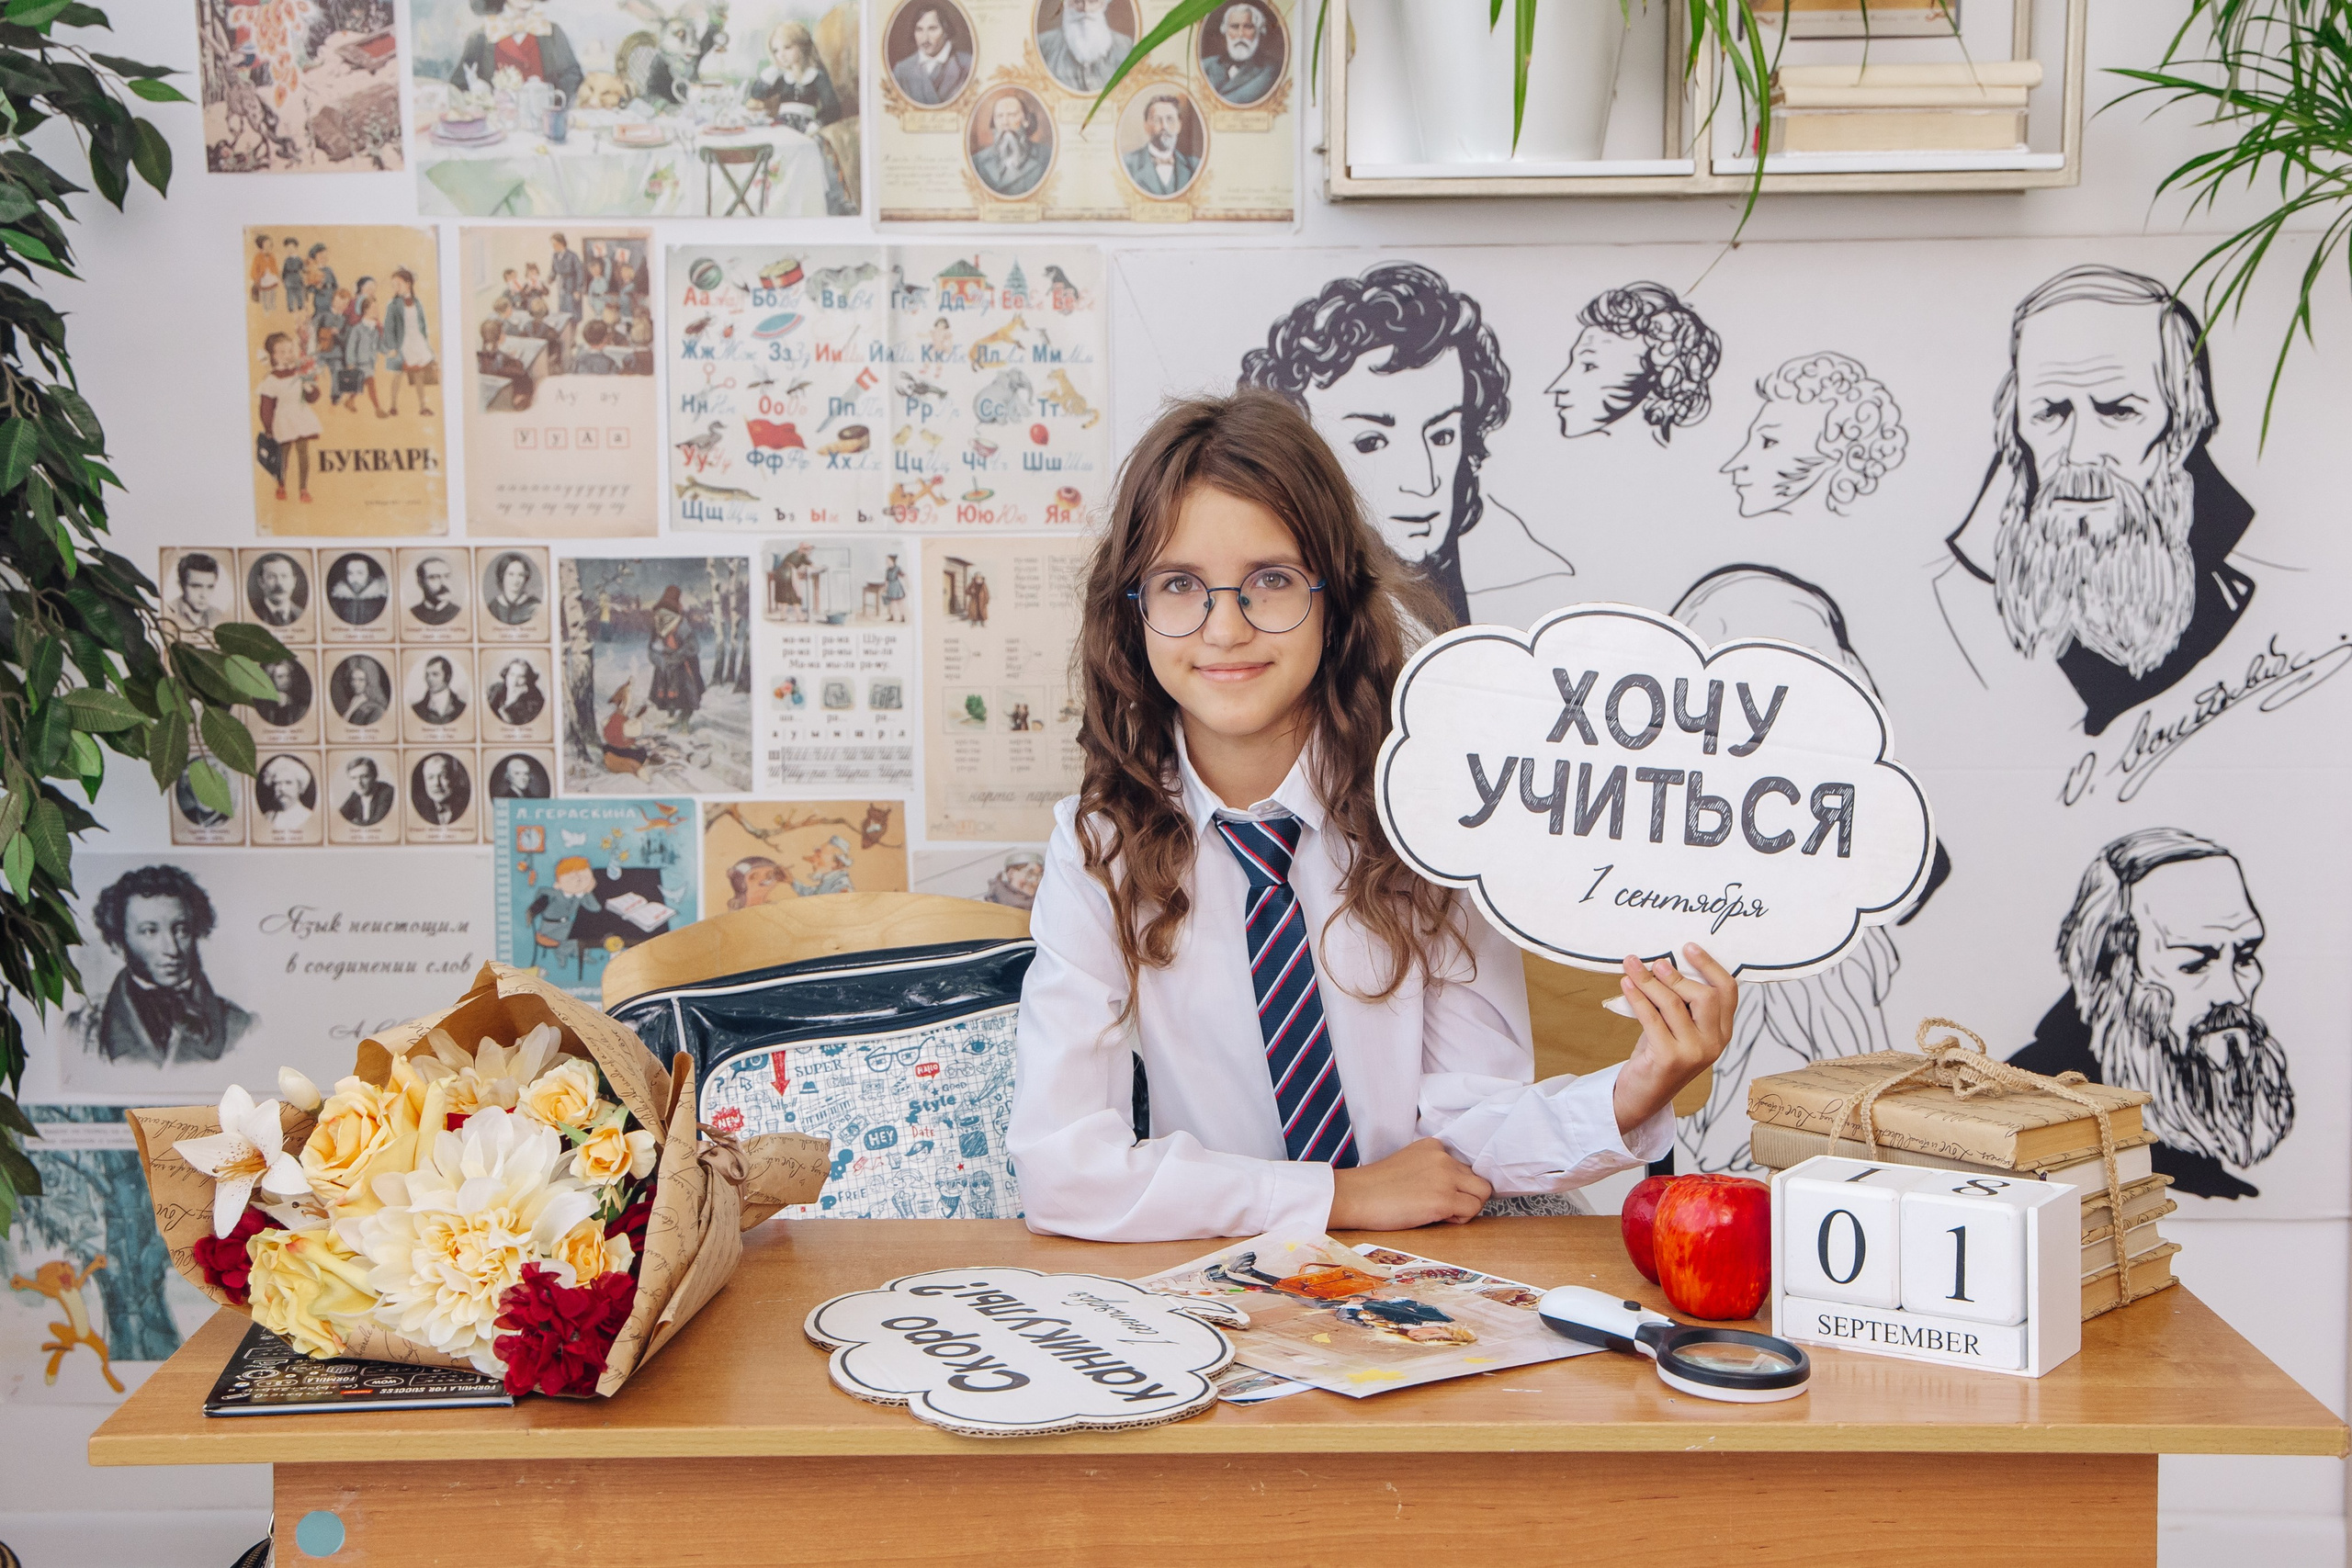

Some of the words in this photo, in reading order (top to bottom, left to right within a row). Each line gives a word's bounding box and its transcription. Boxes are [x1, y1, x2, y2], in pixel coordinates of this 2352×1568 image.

[683, 286, 710, 307] Аа
[752, 288, 777, 307] Бб
[821, 289, 848, 309] Вв
[939, 290, 965, 311] Дд
[682, 340, 715, 360] Жж
[769, 342, 792, 361] Зз
[816, 343, 842, 363] Ии
[922, 344, 944, 363] Кк
[1033, 344, 1062, 363] Мм
[682, 395, 707, 412] Нн
[759, 396, 785, 414] Оо
[829, 397, 855, 416] Пп
[906, 398, 933, 423] Рр
[979, 399, 1004, 415] Сс
[1037, 399, 1059, 417] Тт
[318, 448, 438, 472] БУКВАРЬ
[682, 446, 707, 473] Уу
[746, 448, 784, 474] Фф
[827, 452, 852, 469] Хх
[895, 452, 922, 473] Цц
[962, 452, 987, 470] Чч
[1023, 452, 1062, 471] Шш
[682, 501, 723, 523] Щщ
[957, 505, 994, 524] Юю
[1045, 505, 1070, 524] Яя
[1545, 667, 1789, 757] ХОЧУ
[535, 807, 637, 819] ГЕРАСКИНА
[1458, 752, 1856, 858] УЧИТЬСЯ
[1578, 863, 1614, 904] 1
[1614, 882, 1770, 935] сентября
[258, 904, 344, 940] Язык
[348, 919, 469, 937] неистощим
[286, 952, 300, 974] в
[304, 960, 417, 981] соединении
[425, 952, 474, 974] слов
[795, 1059, 846, 1077] SUPER
[910, 1095, 956, 1112] Style
[718, 1115, 741, 1129] NEW
[1785, 1105, 1816, 1128] Love
[867, 1130, 895, 1146] HEY
[838, 1188, 867, 1202] FREE
[1817, 1314, 1982, 1356] SEPTEMBER
[307, 1376, 357, 1384] FORMULA
[450, 1384, 496, 1393] FORMULA
